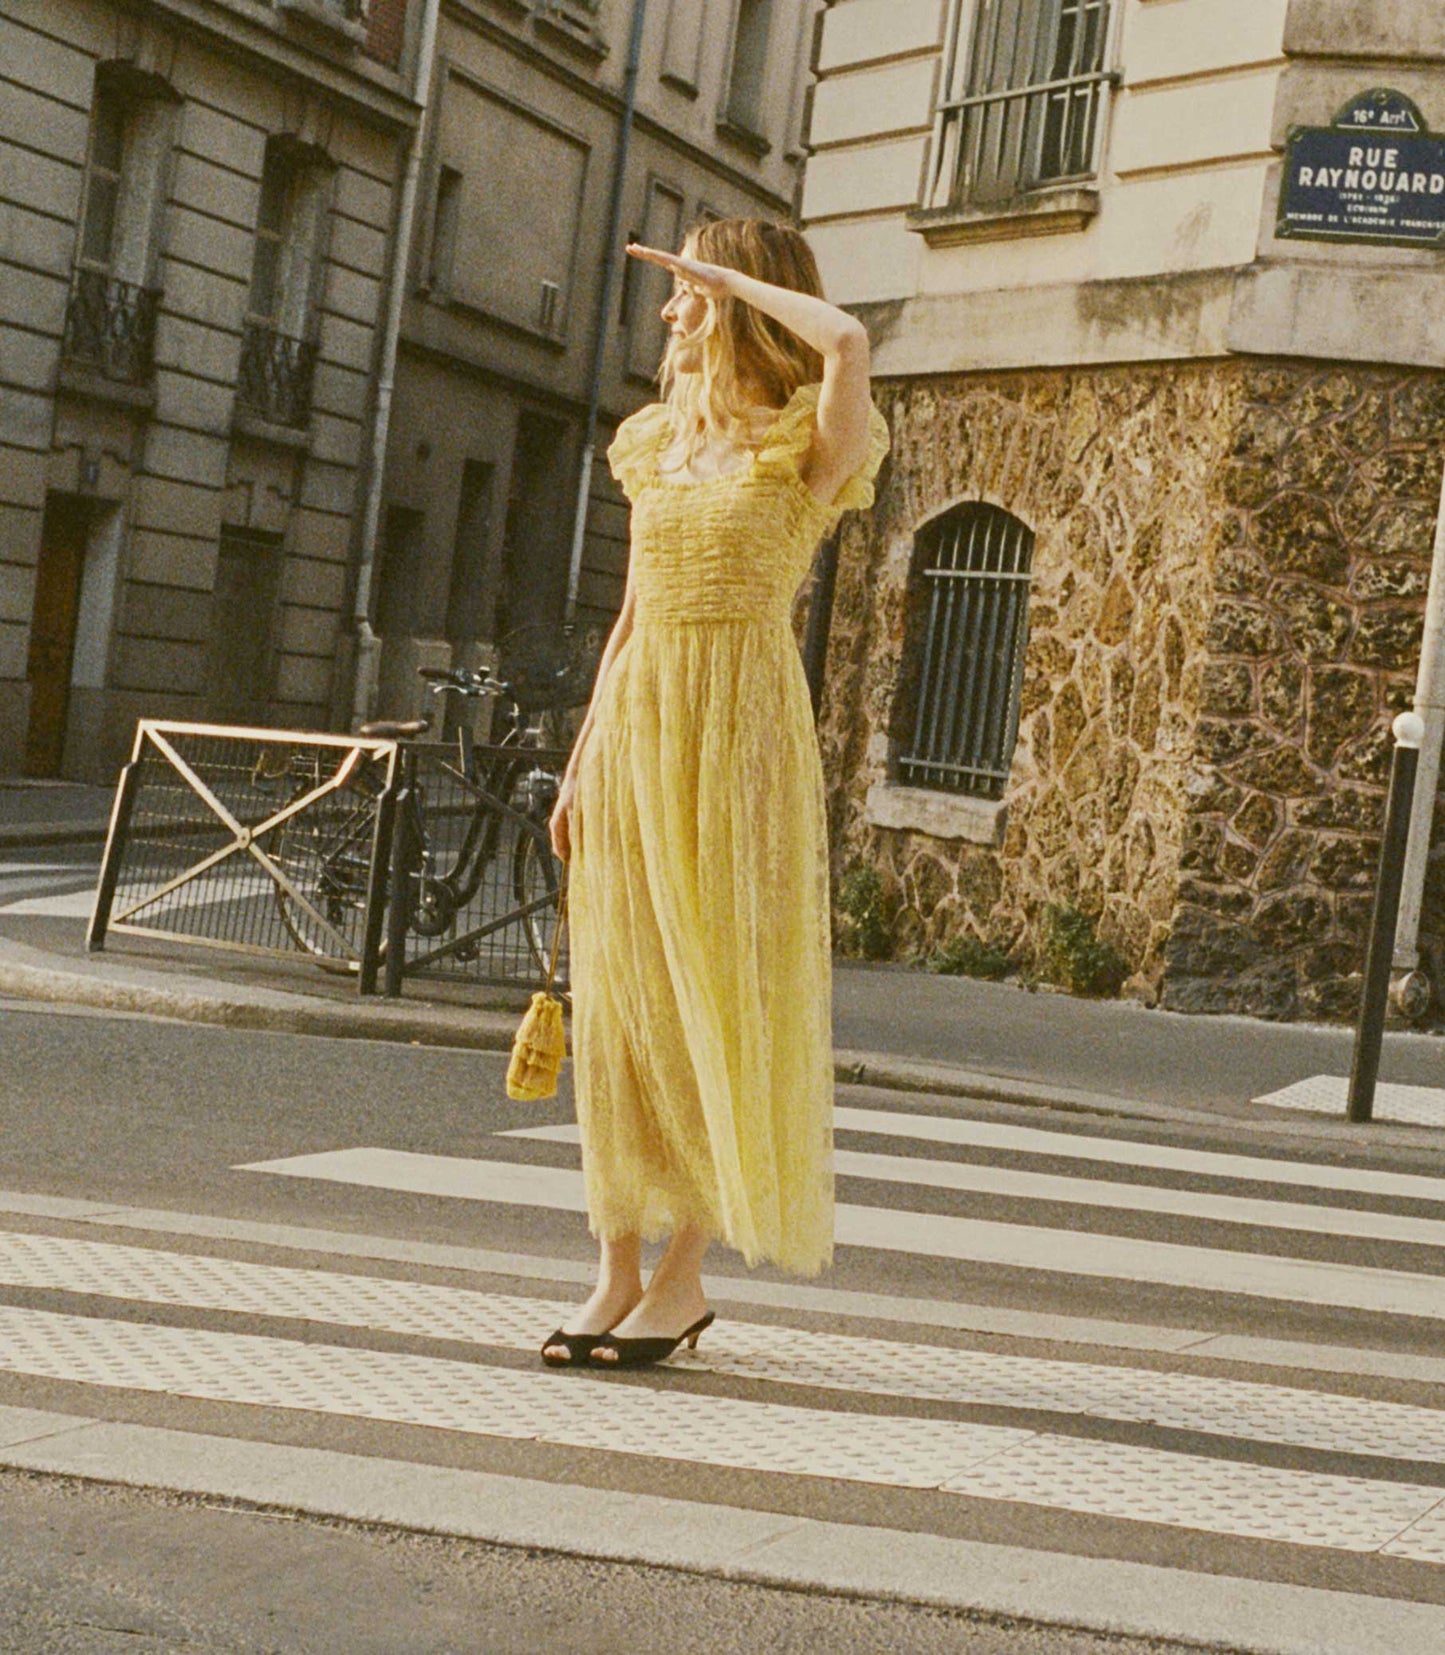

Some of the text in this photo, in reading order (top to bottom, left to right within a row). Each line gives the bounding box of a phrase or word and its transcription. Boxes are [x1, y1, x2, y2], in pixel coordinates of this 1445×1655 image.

[1349, 146, 1399, 169] RUE
[1299, 166, 1444, 194] RAYNOUARD
[1328, 214, 1338, 222] DE
